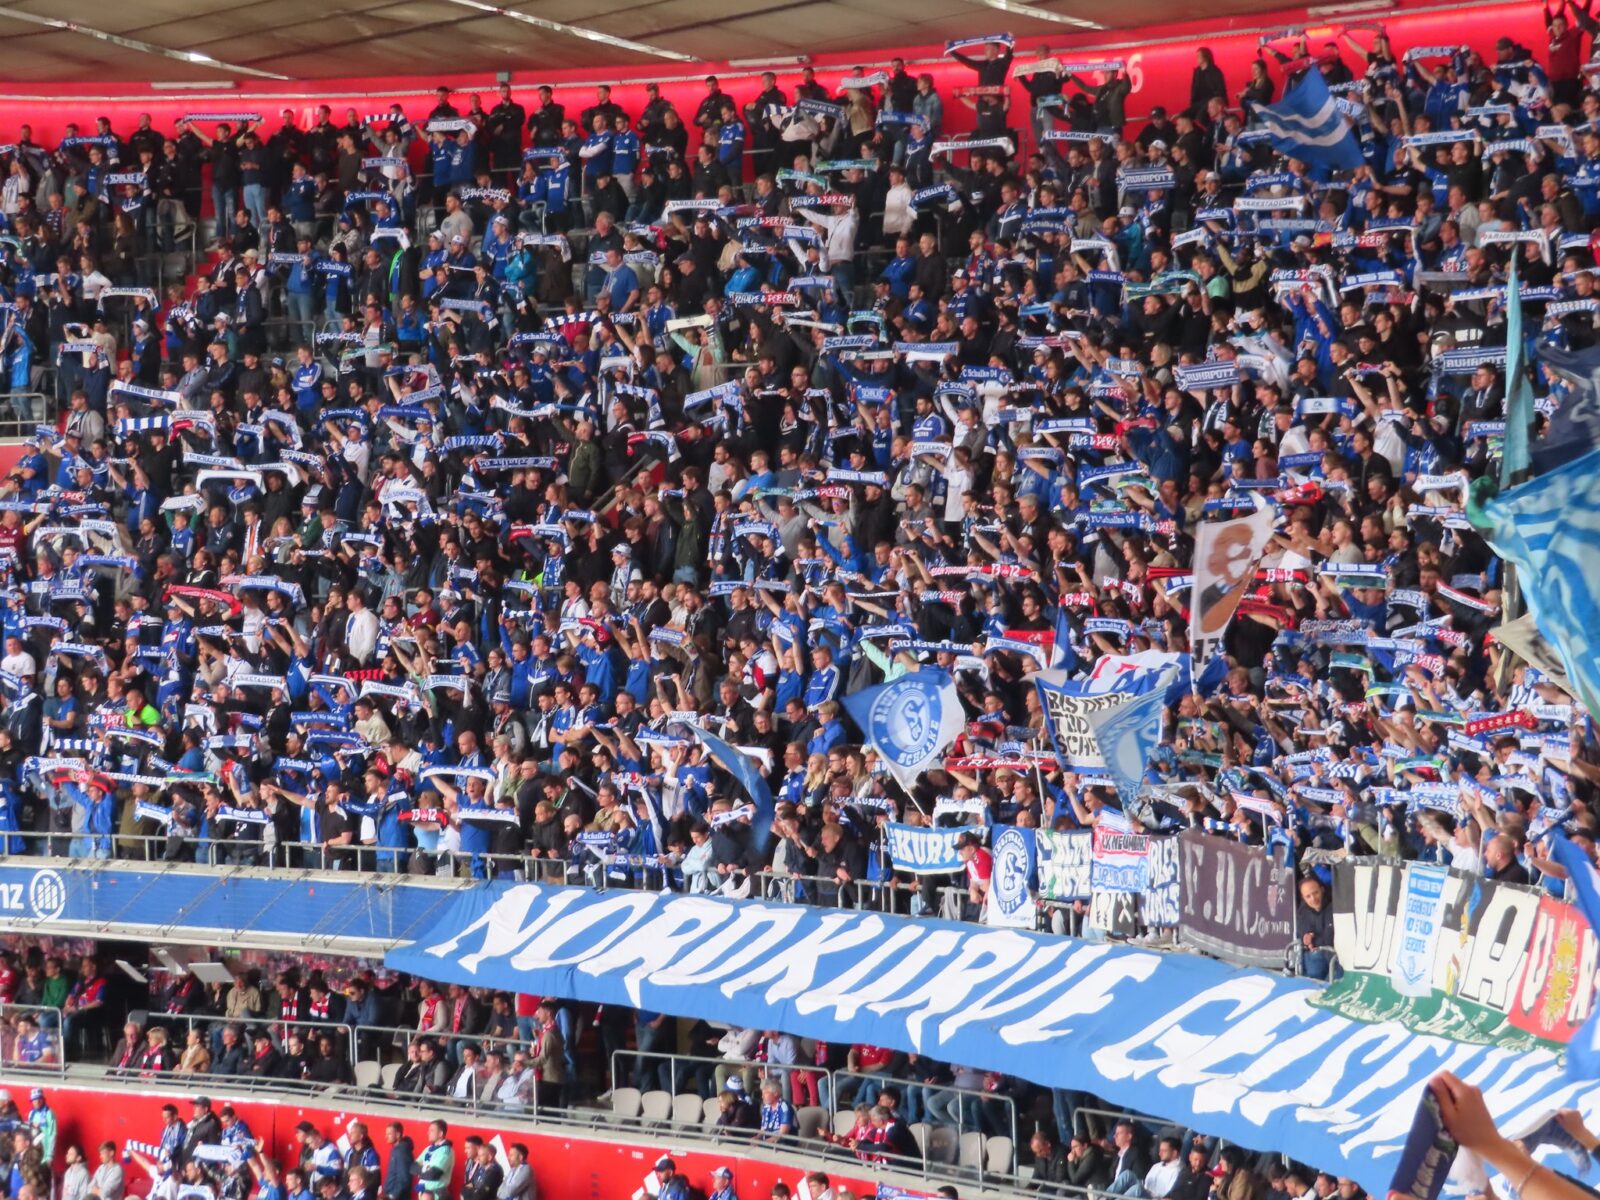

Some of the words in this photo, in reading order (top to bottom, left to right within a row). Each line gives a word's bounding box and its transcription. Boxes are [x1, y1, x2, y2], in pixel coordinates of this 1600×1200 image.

[523, 333, 550, 343] Schalke
[824, 335, 872, 348] Schalke
[1185, 366, 1235, 382] RUHRPOTT
[1266, 569, 1276, 582] 13
[1284, 568, 1293, 581] 12
[1051, 711, 1090, 735] TOD
[896, 719, 940, 767] SCHALKE
[411, 809, 421, 820] 13
[428, 809, 437, 820] 12
[424, 884, 1162, 1055] NORDKURVE
